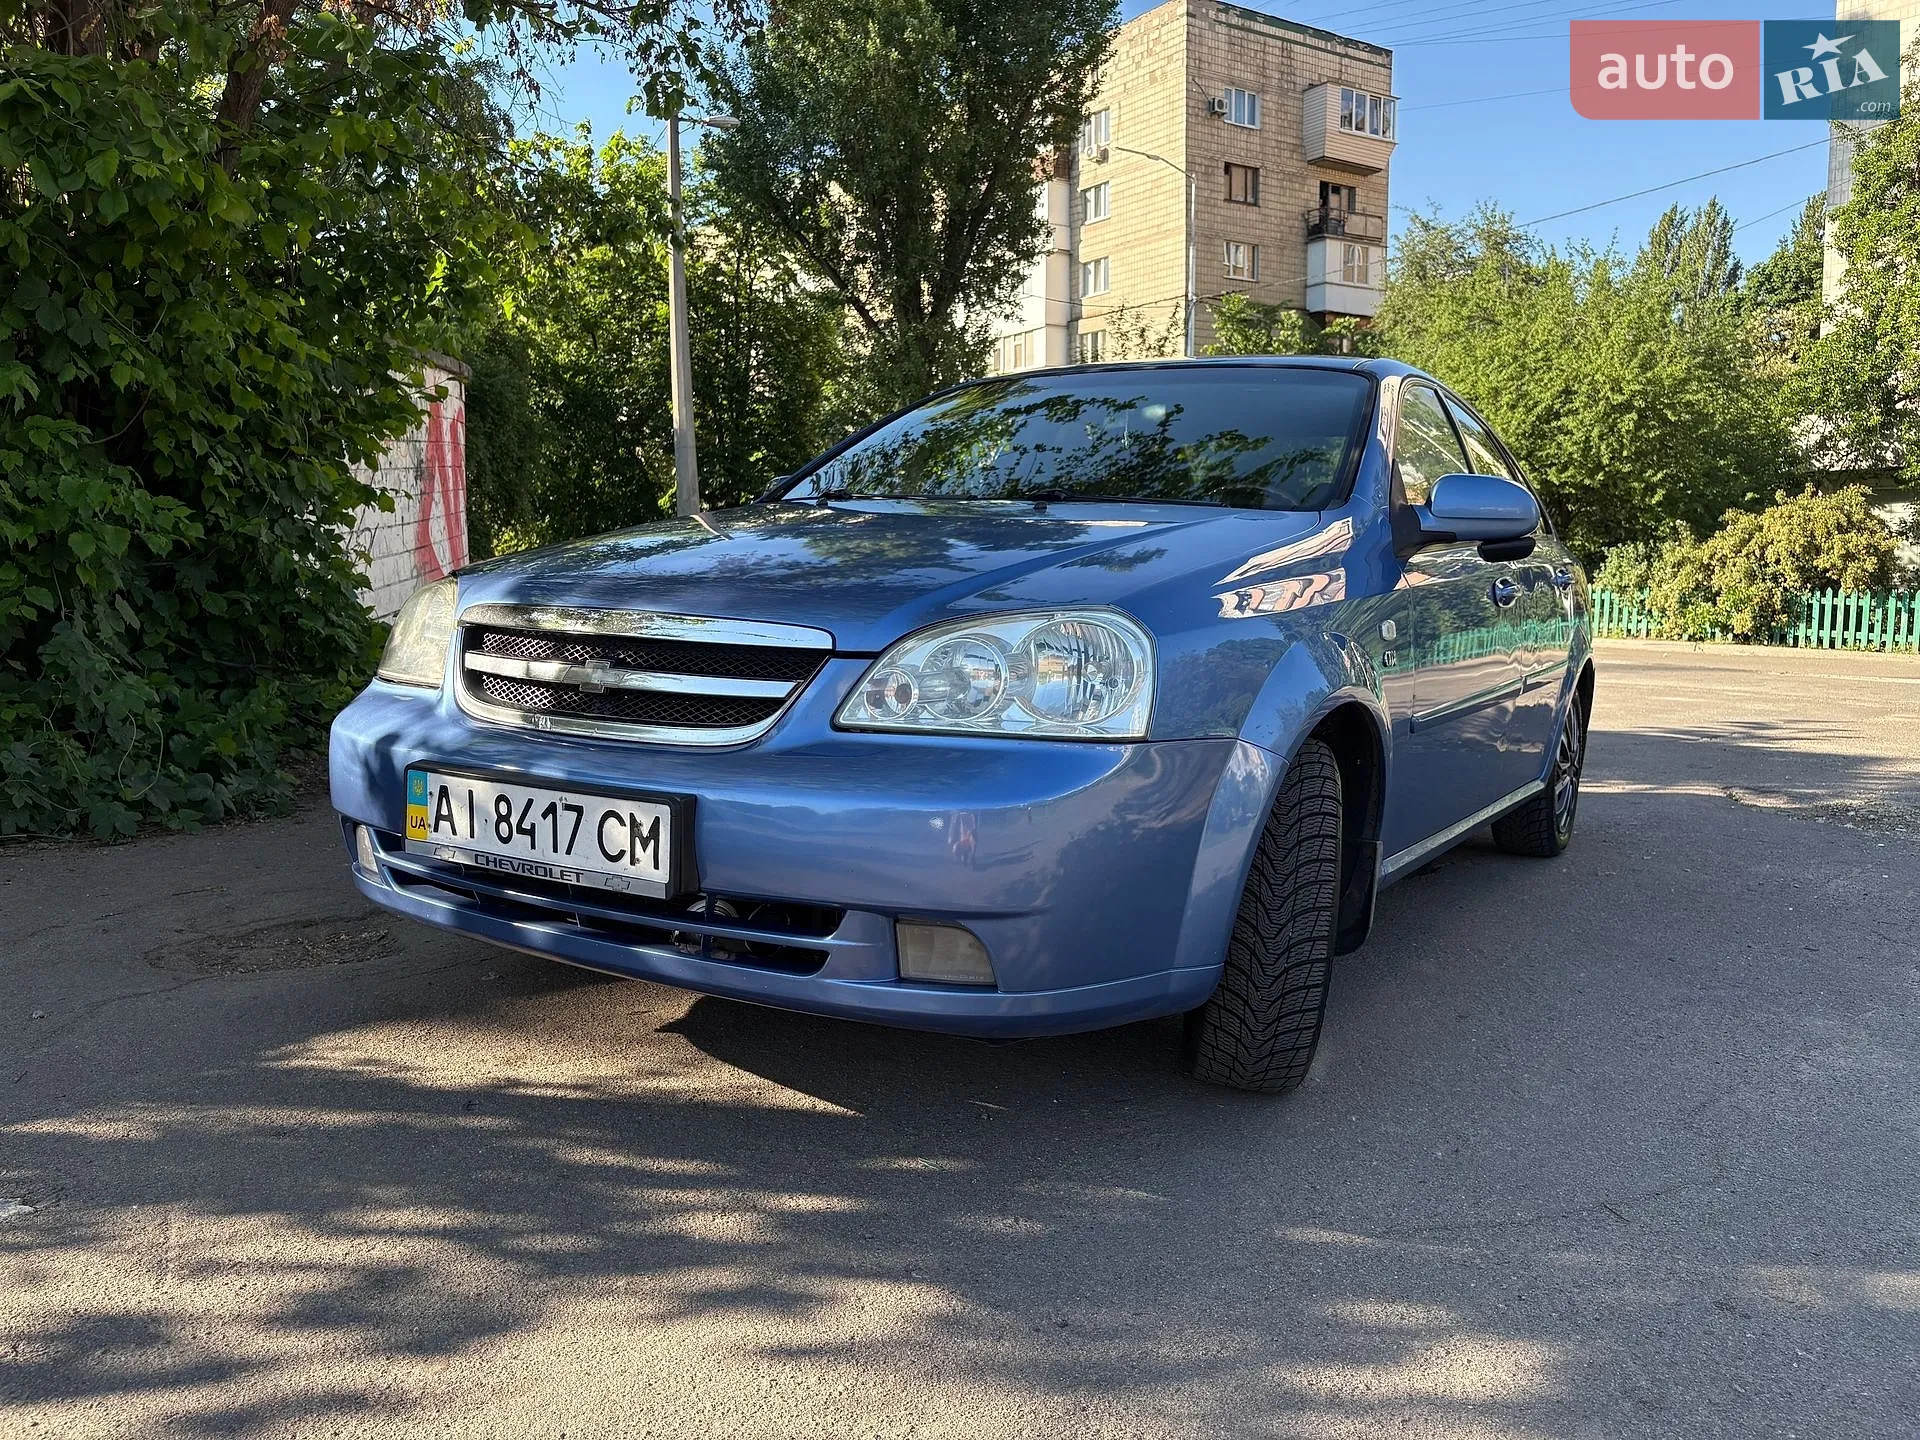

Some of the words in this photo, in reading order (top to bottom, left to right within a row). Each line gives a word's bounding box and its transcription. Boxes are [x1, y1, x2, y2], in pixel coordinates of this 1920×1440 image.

[410, 815, 427, 831] UA
[433, 784, 475, 839] AI
[494, 793, 585, 856] 8417
[597, 809, 661, 871] CM
[474, 853, 584, 883] CHEVROLET
